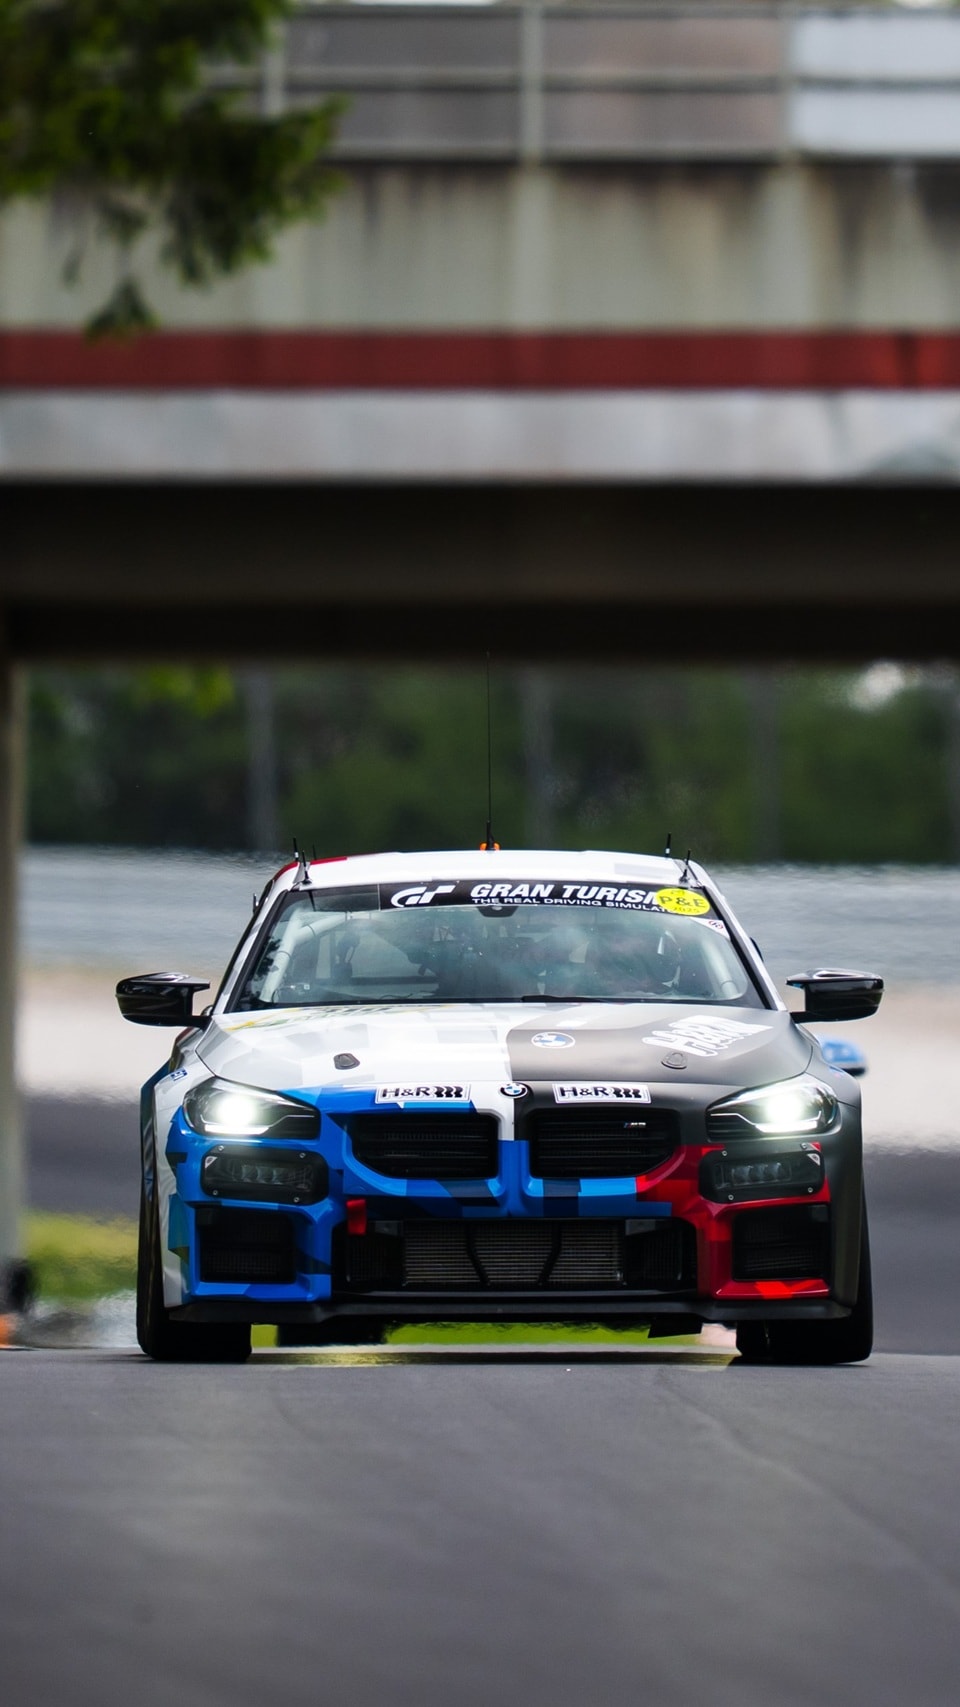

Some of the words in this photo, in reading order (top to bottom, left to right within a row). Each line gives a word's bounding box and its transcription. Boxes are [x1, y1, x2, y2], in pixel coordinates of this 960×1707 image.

[470, 884, 554, 898] GRAN
[543, 898, 602, 906] DRIVING
[382, 1086, 430, 1098] H&R
[560, 1086, 609, 1097] H&R
